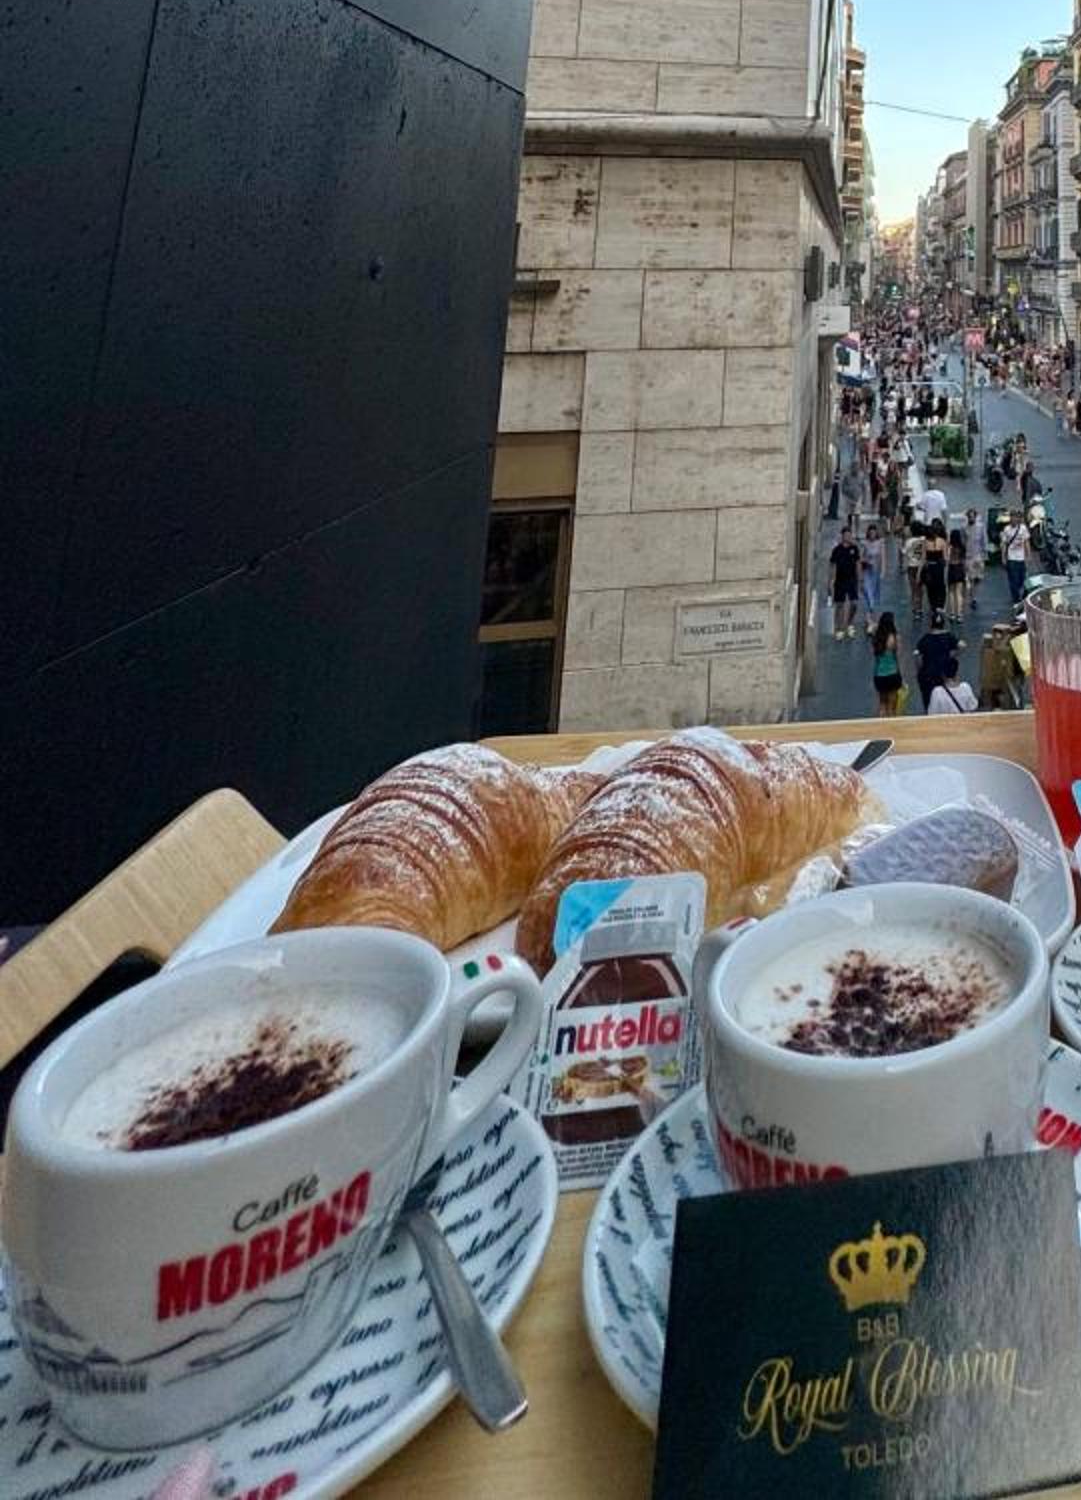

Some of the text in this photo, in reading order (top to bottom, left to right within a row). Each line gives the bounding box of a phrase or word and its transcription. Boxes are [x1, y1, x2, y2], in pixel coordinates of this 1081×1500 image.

[555, 1005, 682, 1056] nutella
[232, 1173, 320, 1232] Caffè
[157, 1168, 372, 1323] MORENO
[857, 1313, 900, 1342] B&B
[736, 1337, 1045, 1455] Royal Blessing
[842, 1433, 932, 1470] TOLEDO
